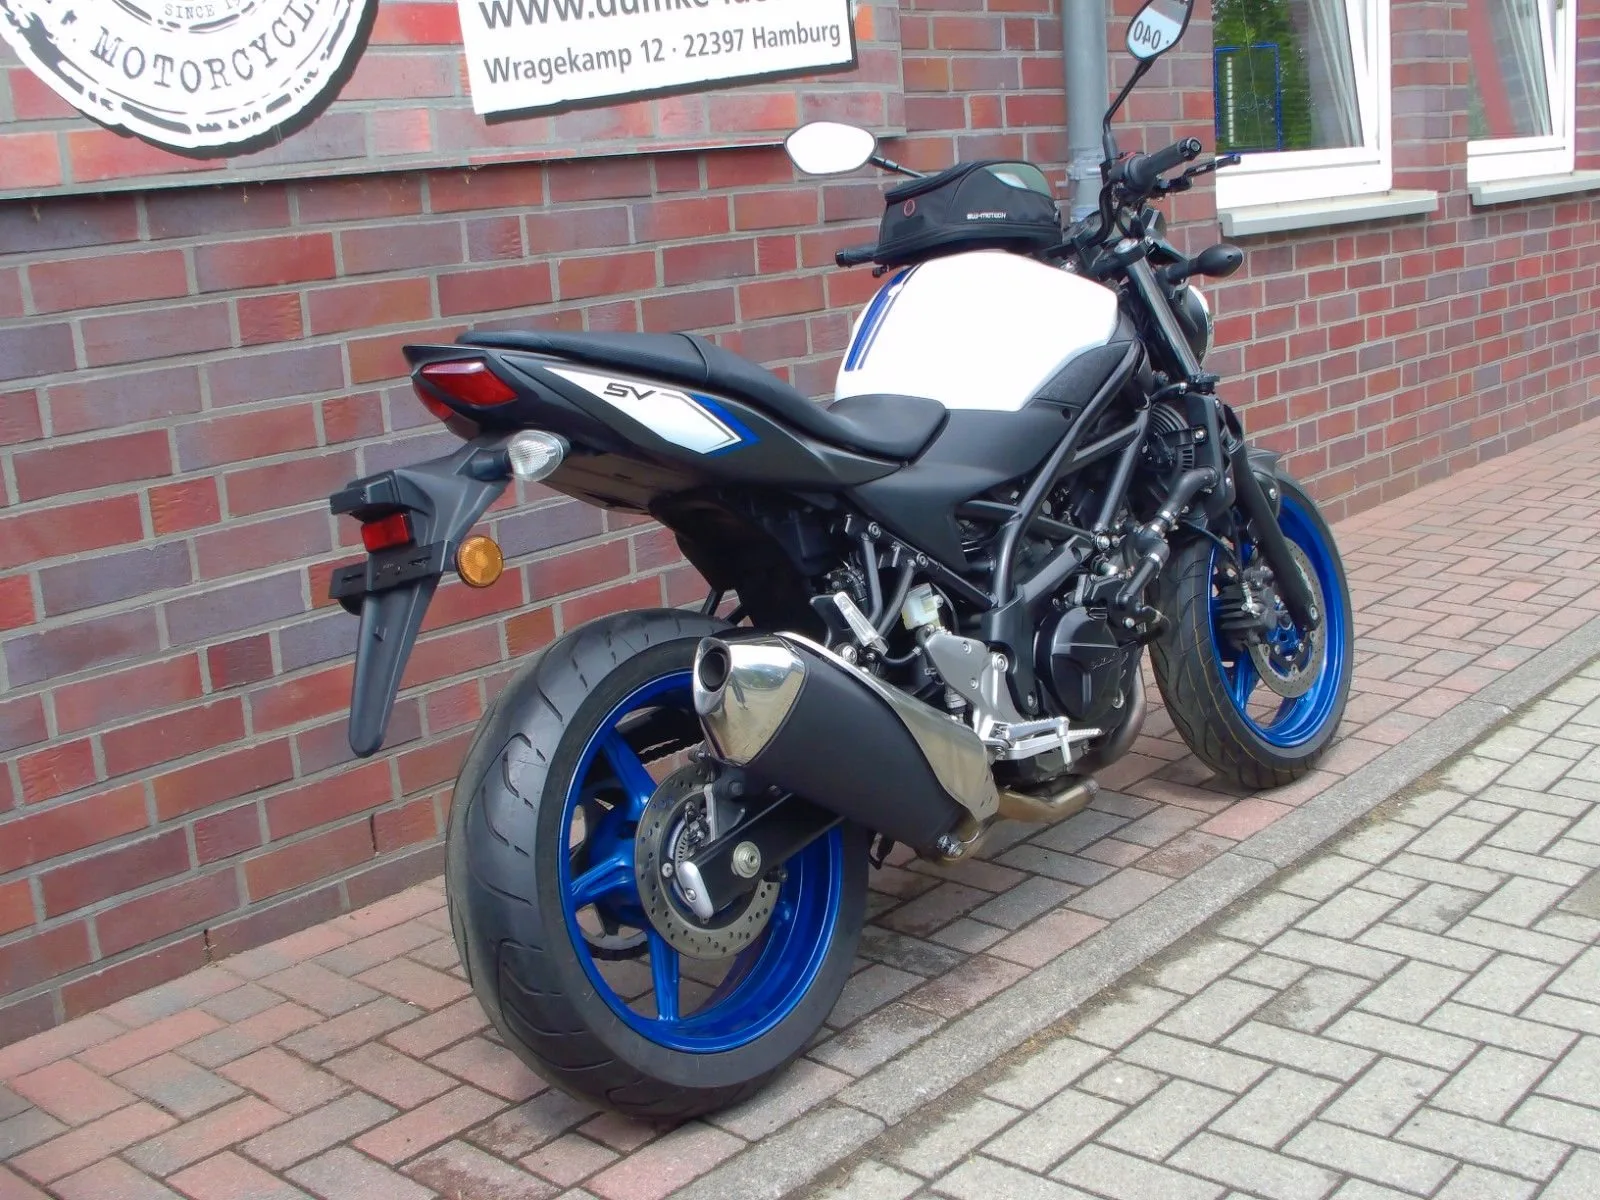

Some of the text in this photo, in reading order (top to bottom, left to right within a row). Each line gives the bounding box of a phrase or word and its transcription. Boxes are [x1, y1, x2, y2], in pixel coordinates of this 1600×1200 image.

[164, 3, 215, 19] SINCE
[90, 0, 320, 94] MOTORCYCL
[484, 47, 632, 84] Wragekamp
[640, 38, 666, 64] 12
[684, 29, 745, 58] 22397
[752, 21, 841, 49] Hamburg
[603, 382, 656, 401] SV
